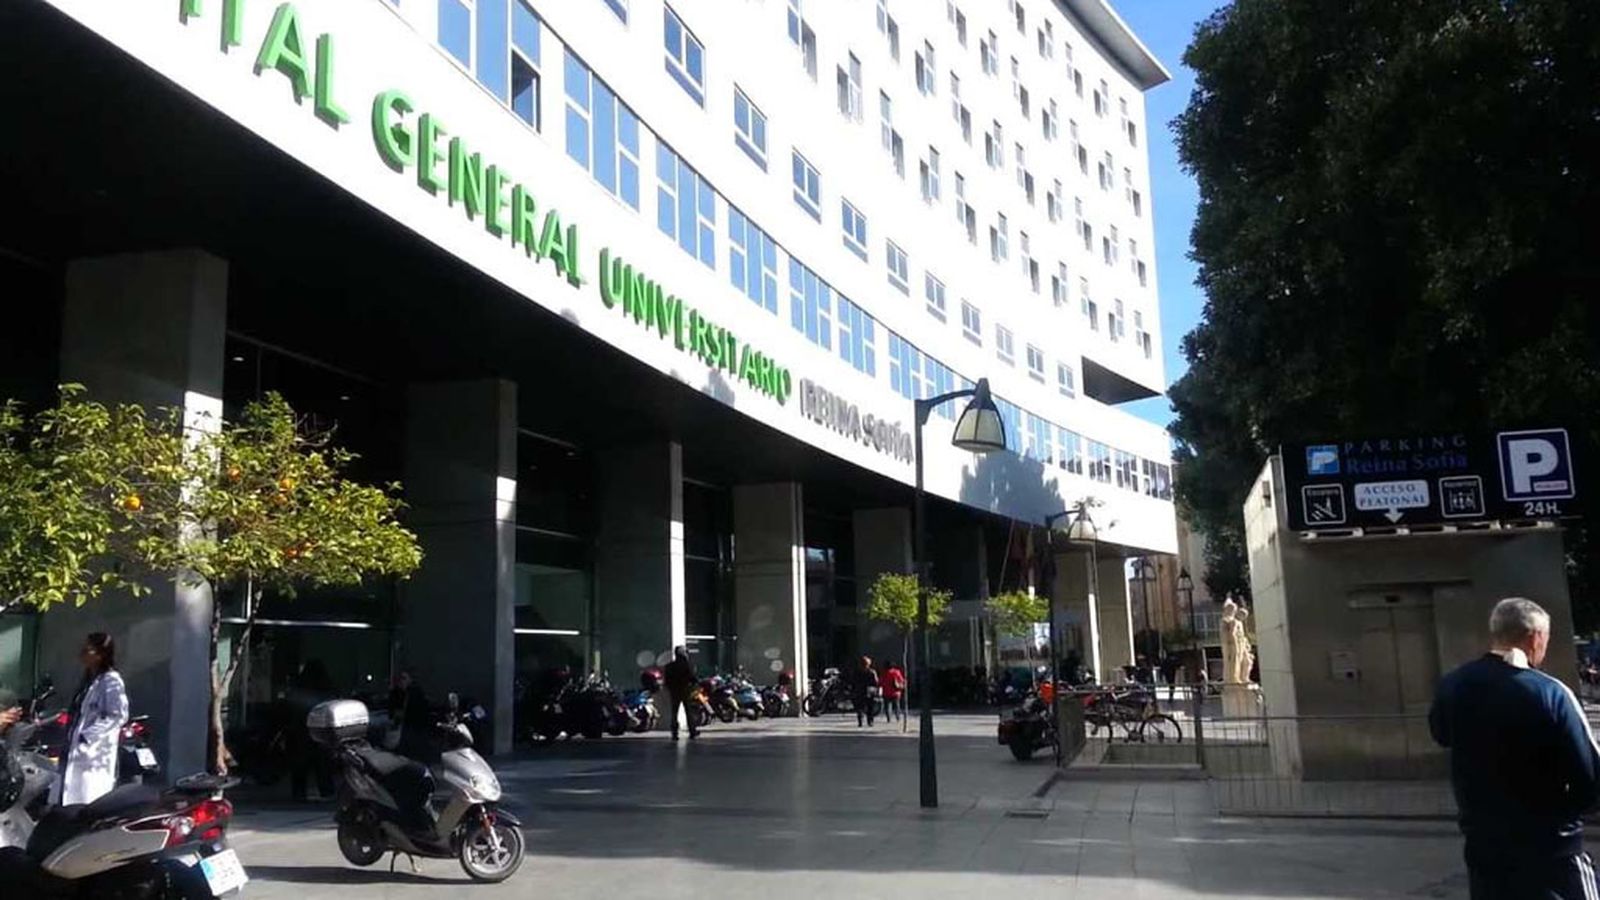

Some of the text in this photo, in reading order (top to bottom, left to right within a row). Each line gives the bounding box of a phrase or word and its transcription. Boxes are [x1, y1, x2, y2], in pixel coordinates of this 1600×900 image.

[179, 0, 352, 131] AL
[371, 87, 588, 288] GENERAL
[599, 247, 792, 406] UNIVERSITARIO
[800, 378, 862, 442] REINA
[1343, 433, 1467, 453] PARKING
[1345, 454, 1407, 474] Reina
[1507, 438, 1560, 494] P
[1360, 493, 1426, 507] PEATONAL
[1363, 485, 1416, 495] ACCESO
